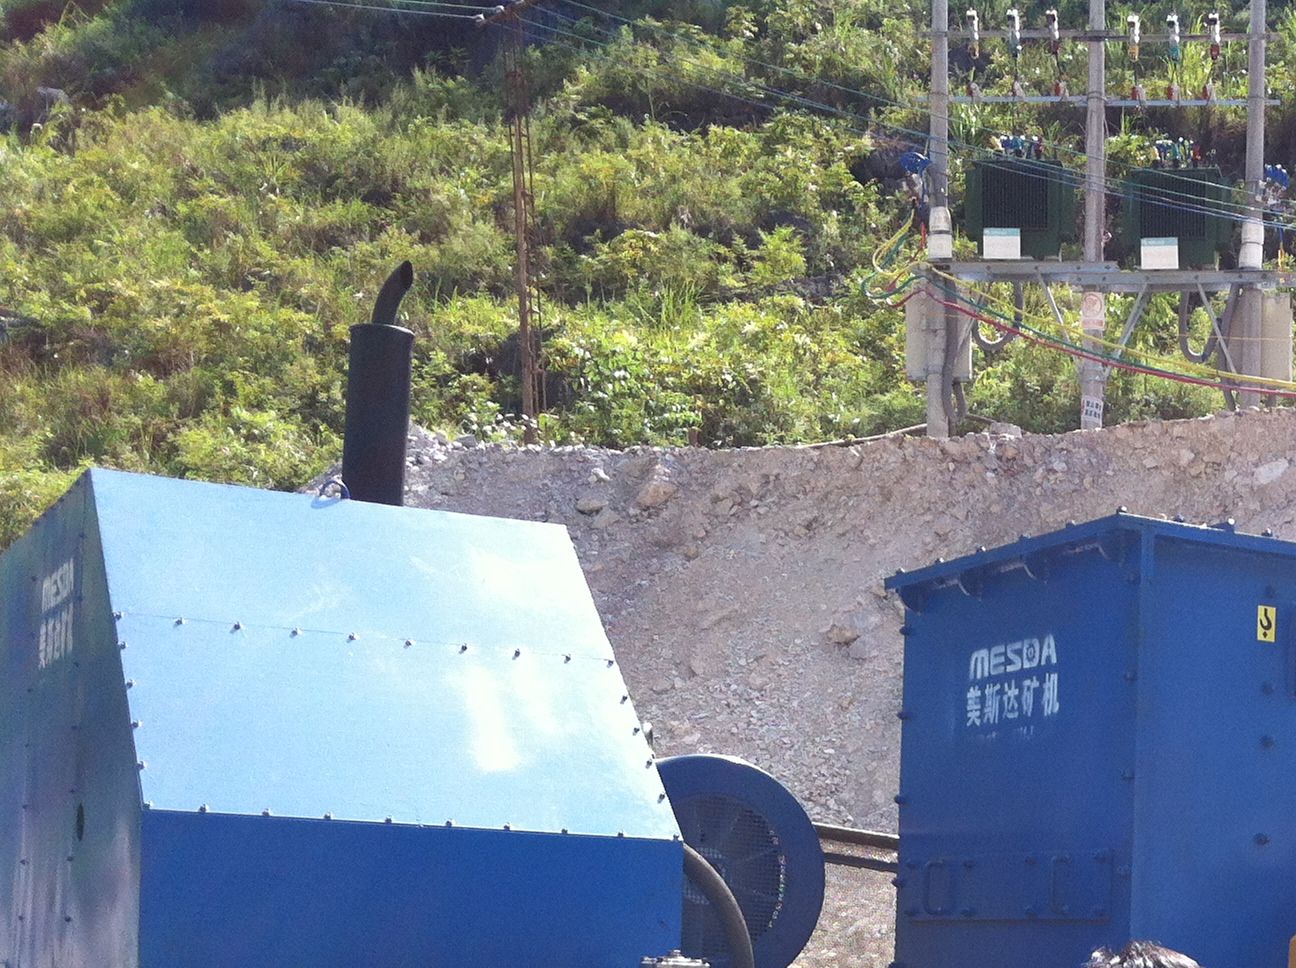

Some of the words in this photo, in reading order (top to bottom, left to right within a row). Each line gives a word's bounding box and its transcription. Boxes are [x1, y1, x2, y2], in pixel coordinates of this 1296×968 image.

[42, 557, 74, 614] MESDA
[969, 634, 1057, 680] MESDA
[966, 672, 1060, 727] 美斯达矿机
